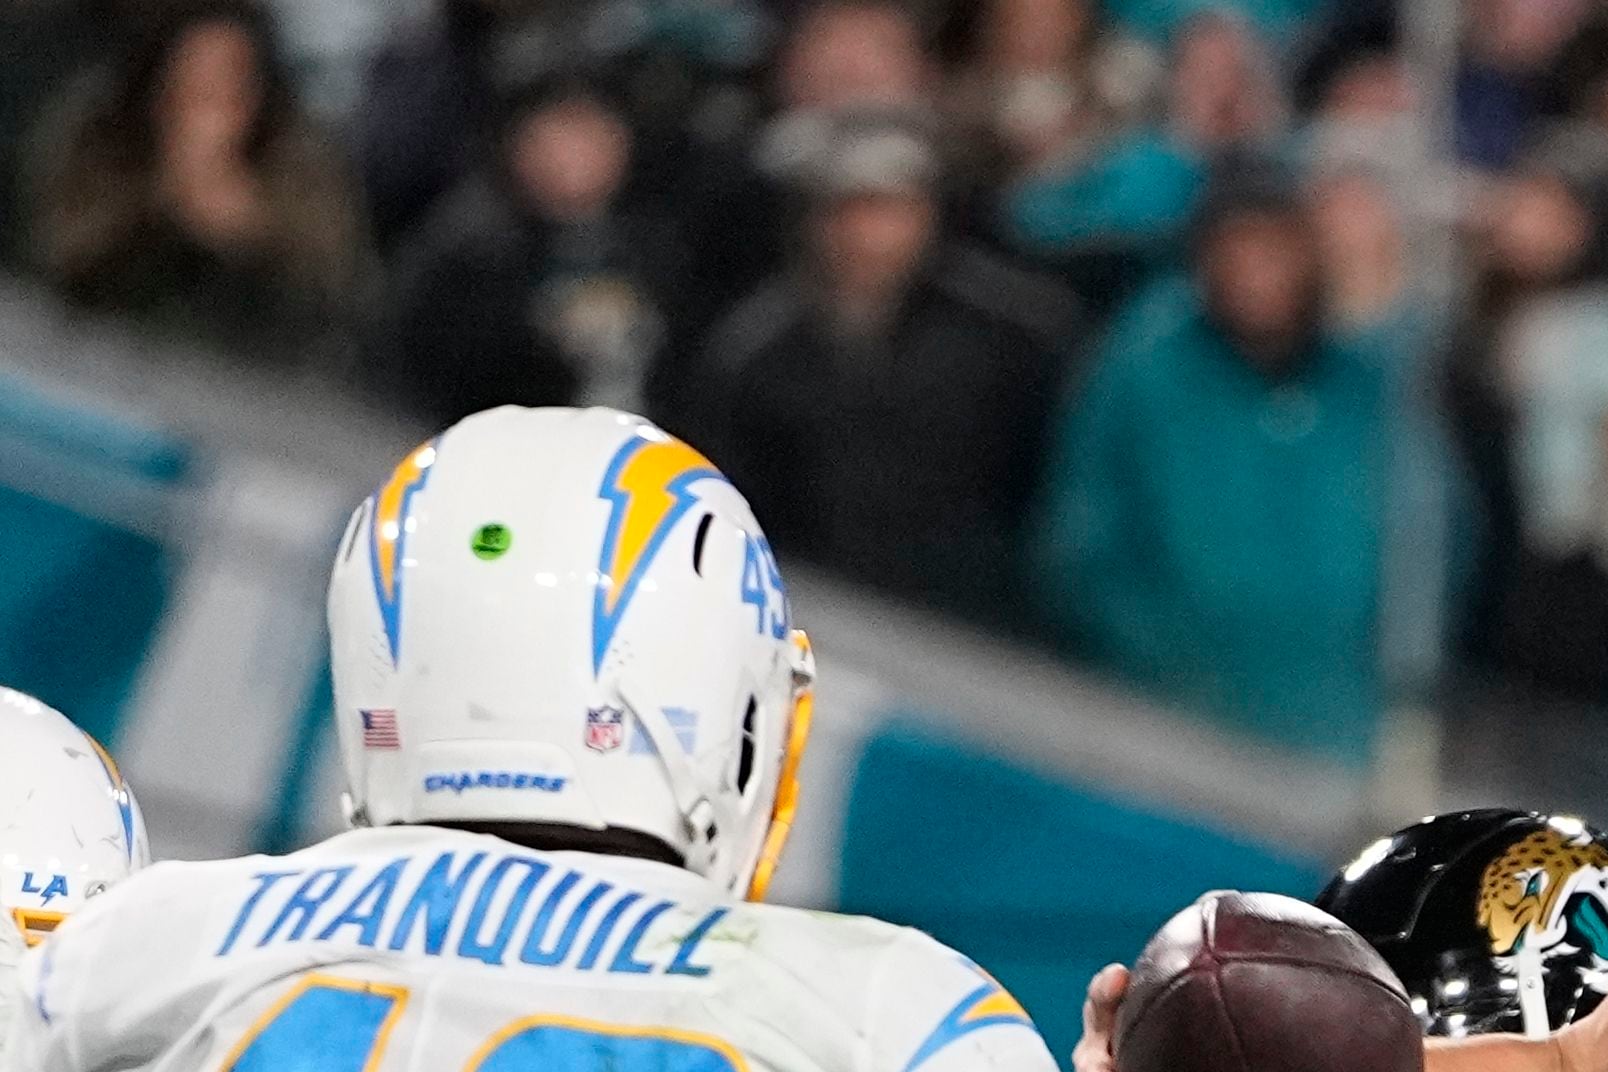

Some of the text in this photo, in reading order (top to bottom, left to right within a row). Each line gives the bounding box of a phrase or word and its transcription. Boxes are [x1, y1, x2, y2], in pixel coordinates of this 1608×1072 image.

[424, 770, 567, 795] CHARGERS
[21, 871, 69, 907] LA
[215, 851, 730, 977] TRANQUILL
